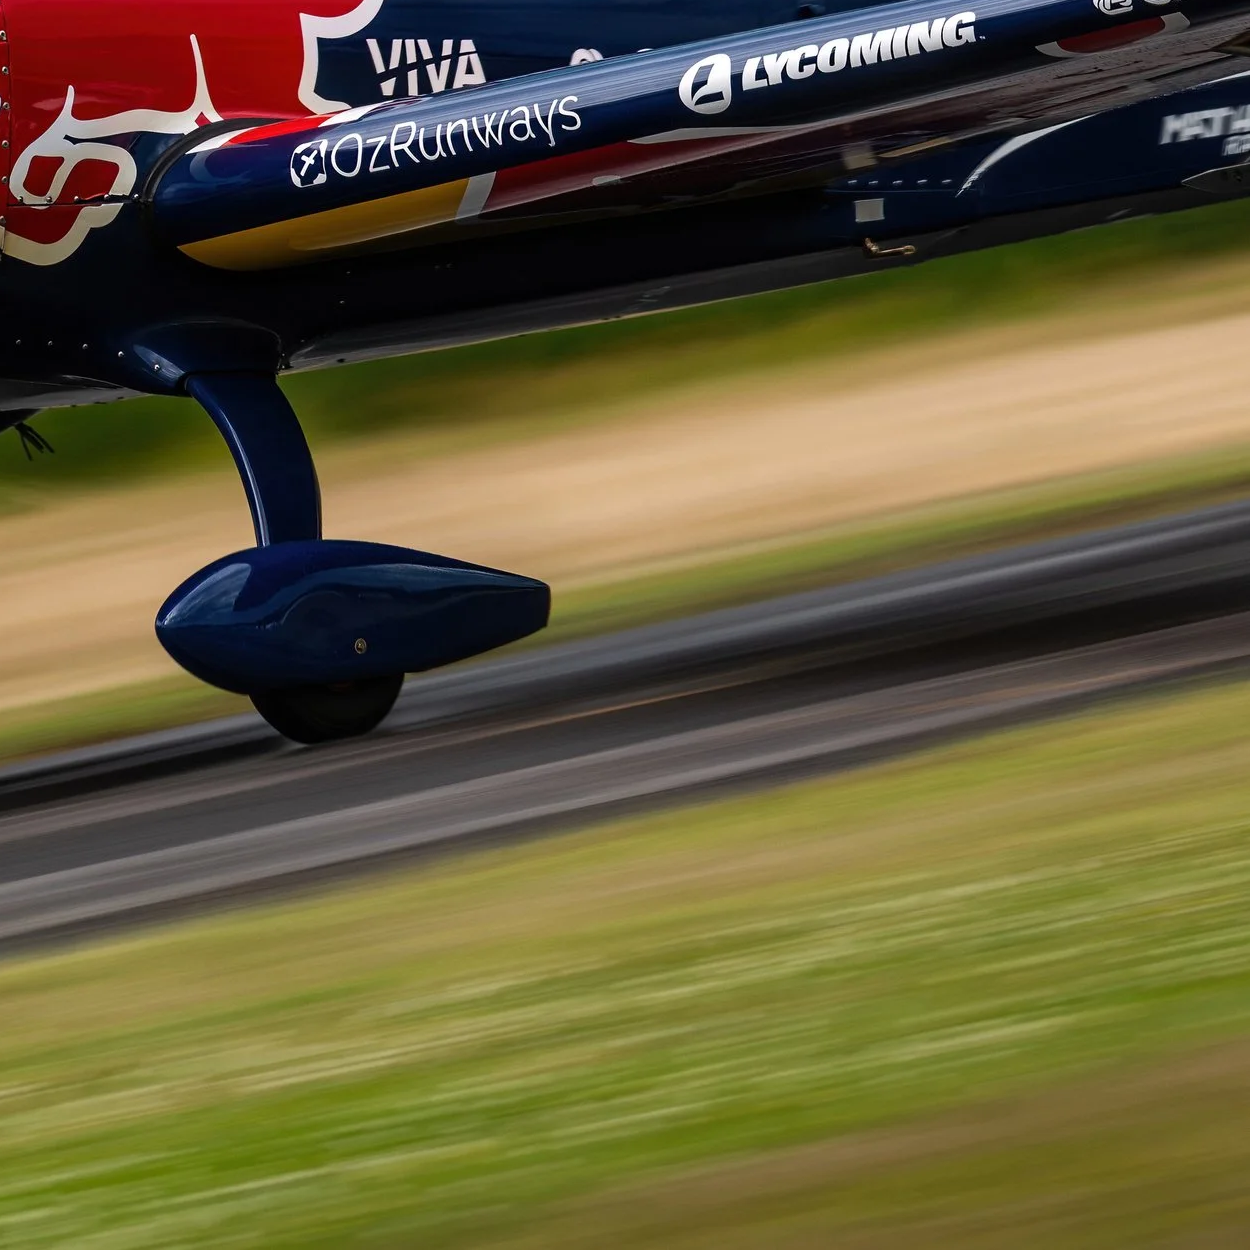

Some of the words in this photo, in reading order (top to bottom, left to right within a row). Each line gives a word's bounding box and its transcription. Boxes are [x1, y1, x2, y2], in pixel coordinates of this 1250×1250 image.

[366, 38, 487, 96] VIVA
[742, 11, 977, 91] LYCOMING
[330, 95, 582, 178] OzRunways
